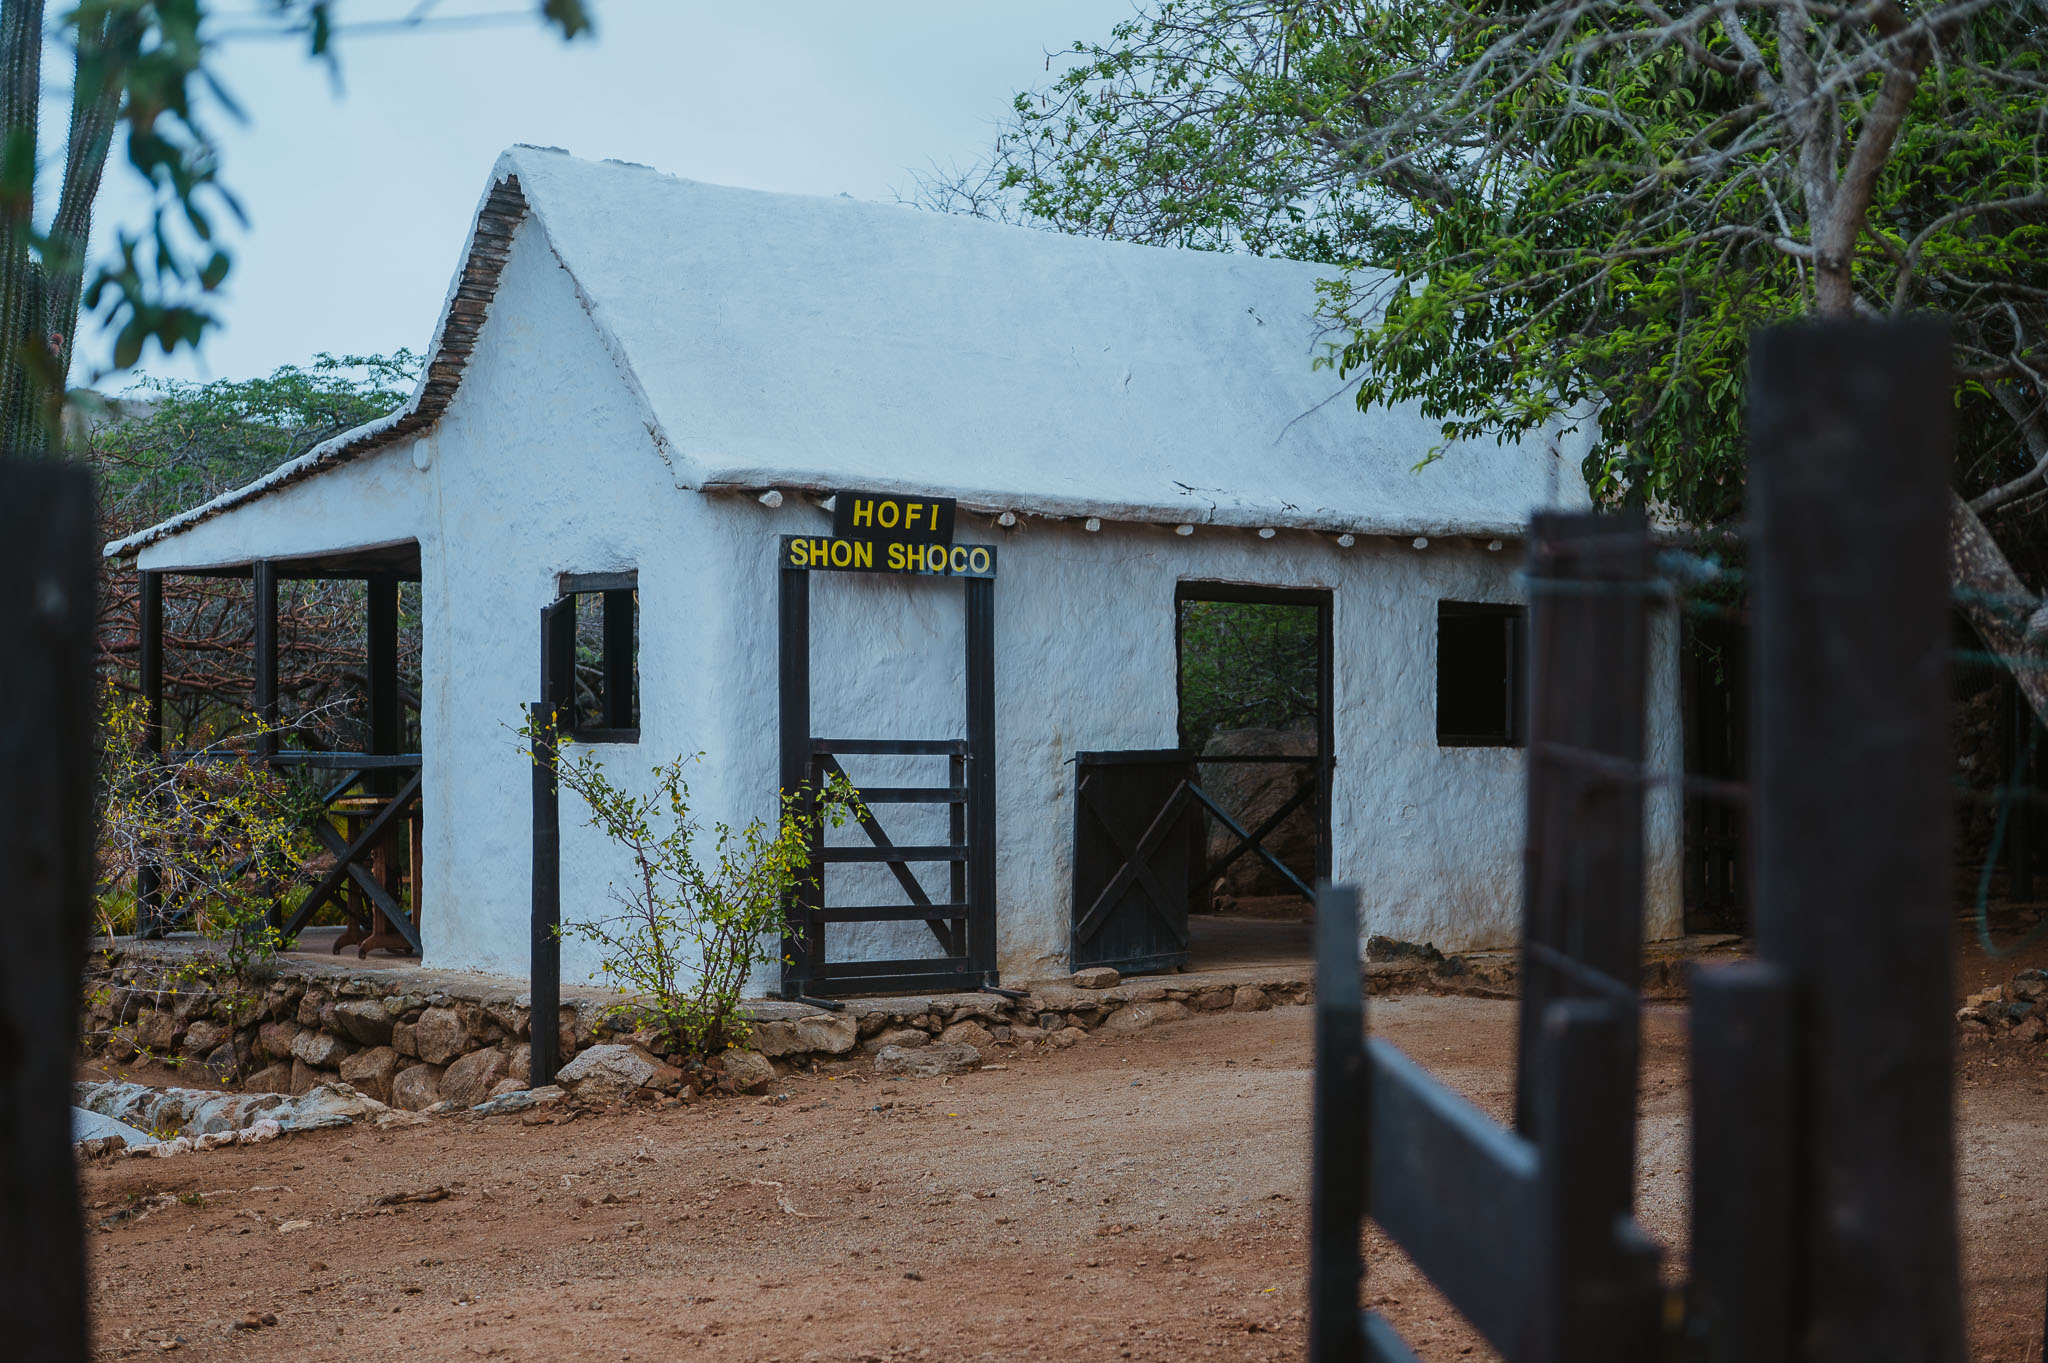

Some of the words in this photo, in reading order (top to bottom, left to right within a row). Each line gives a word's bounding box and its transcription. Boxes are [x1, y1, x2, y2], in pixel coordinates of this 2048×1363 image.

[853, 499, 940, 532] HOFI
[790, 538, 873, 568] SHON
[887, 541, 991, 573] SHOCO
